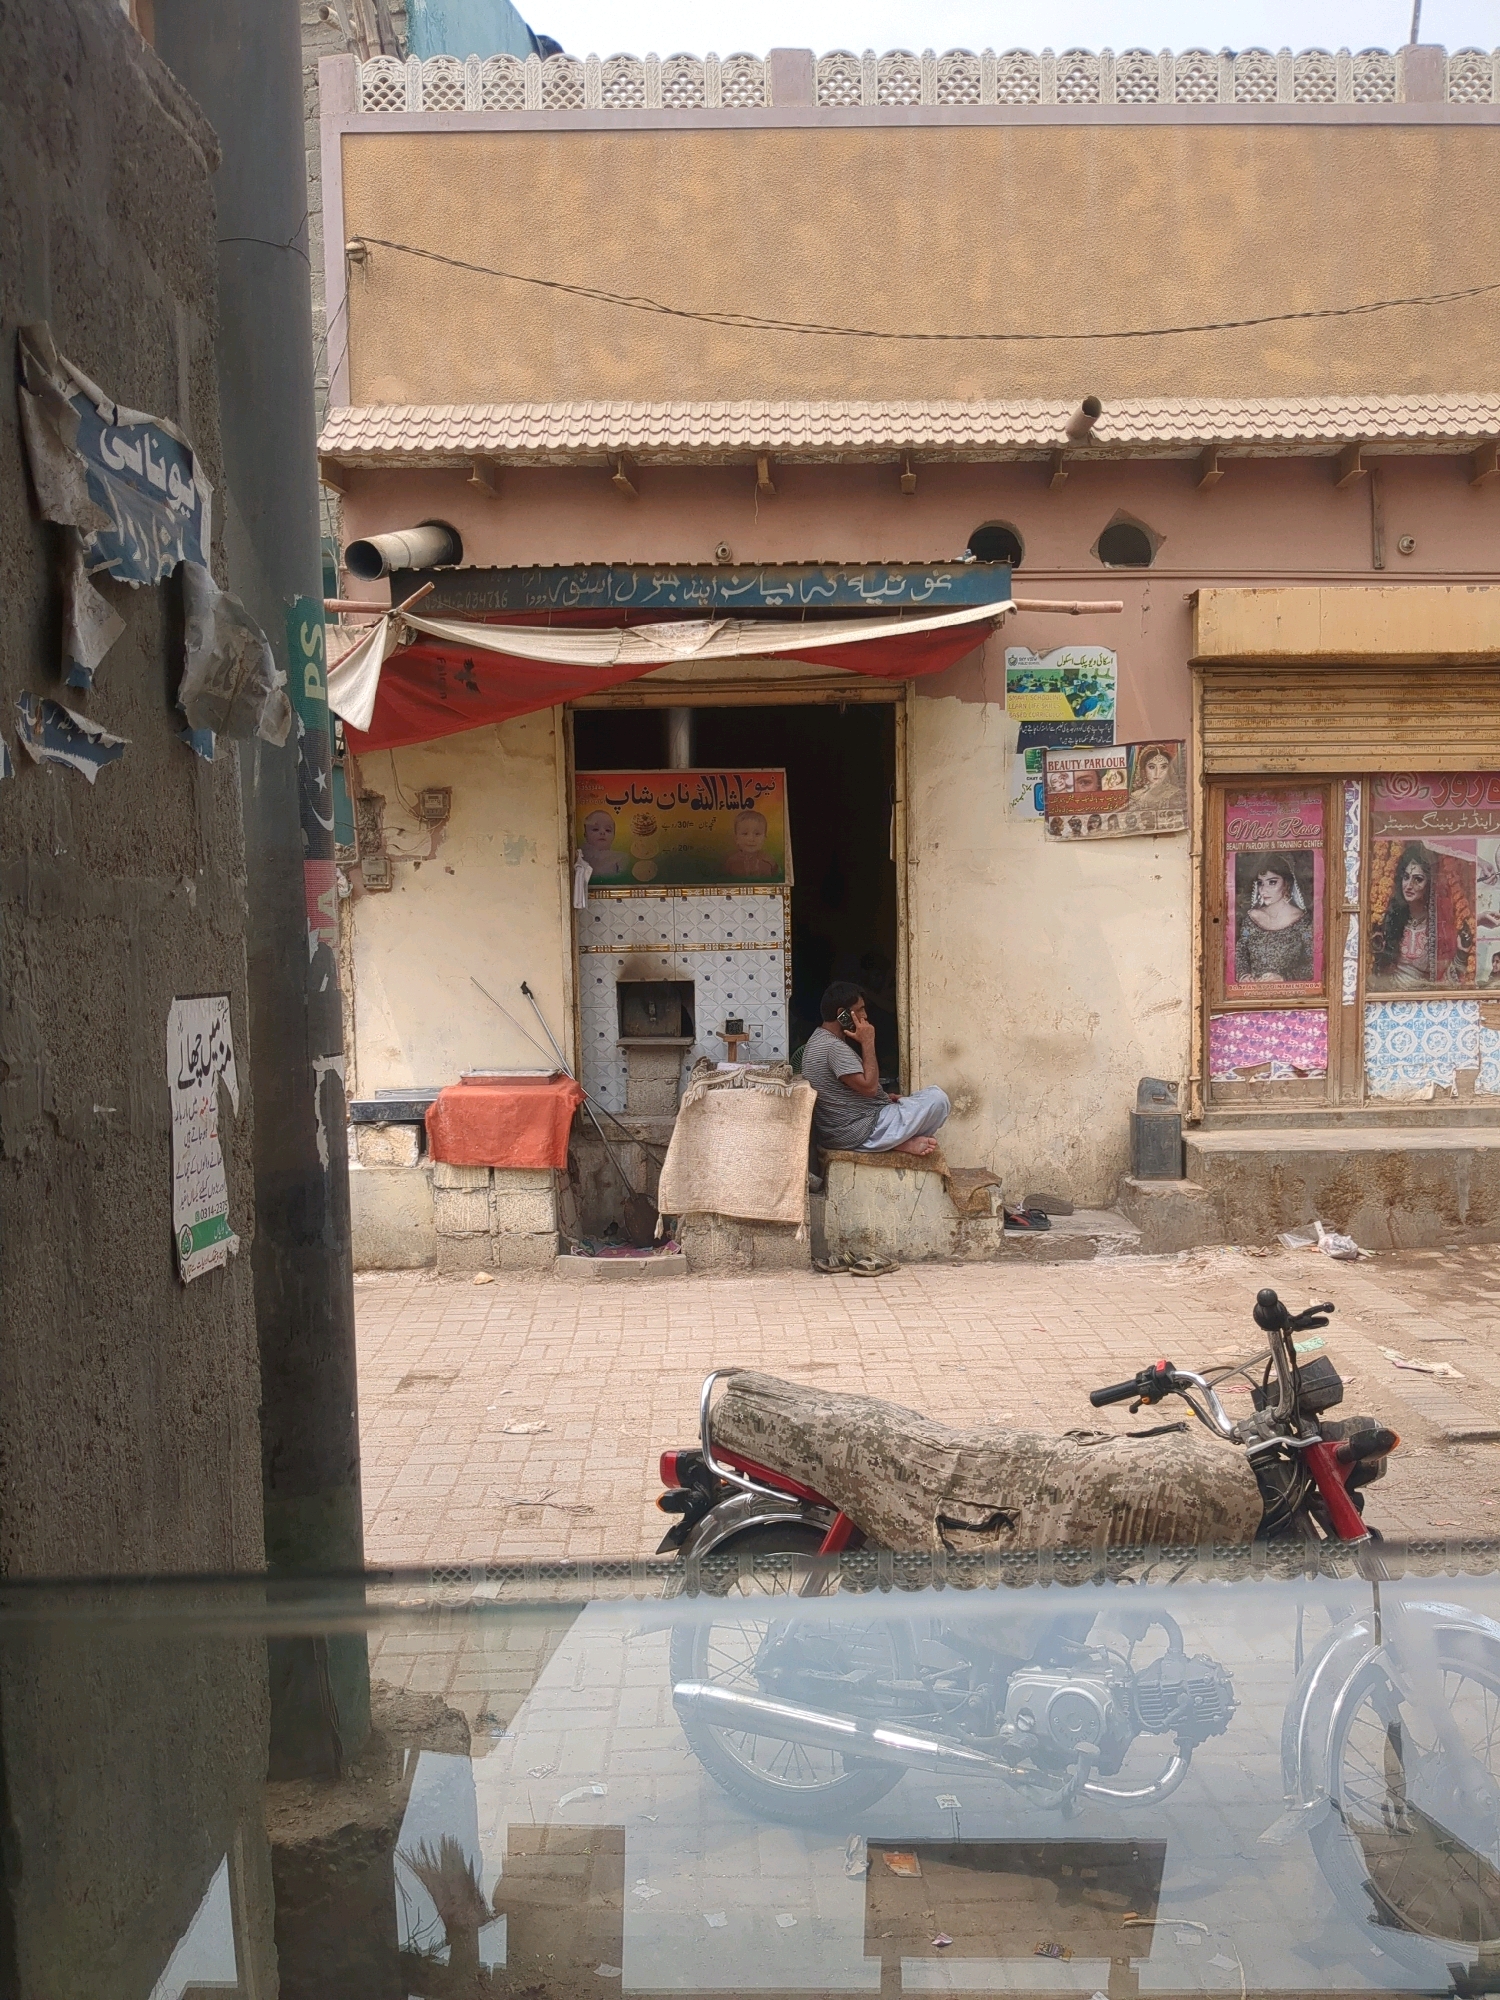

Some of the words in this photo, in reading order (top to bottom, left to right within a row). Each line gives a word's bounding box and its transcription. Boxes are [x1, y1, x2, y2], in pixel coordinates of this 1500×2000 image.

[100, 424, 195, 519] یونانی
[1048, 759, 1082, 771] BEAUTY
[1084, 756, 1126, 769] PARLOUR
[604, 782, 654, 814] شاپ
[656, 782, 690, 811] نان
[1227, 817, 1275, 840] Mah
[1276, 816, 1321, 838] Rose
[1467, 809, 1492, 829] اینڈ
[1226, 842, 1245, 850] BEAUTY
[1245, 841, 1270, 850] PARLOUR
[1277, 840, 1302, 848] TRAINING
[1302, 839, 1324, 847] CENTER
[177, 1034, 203, 1090] چھالے
